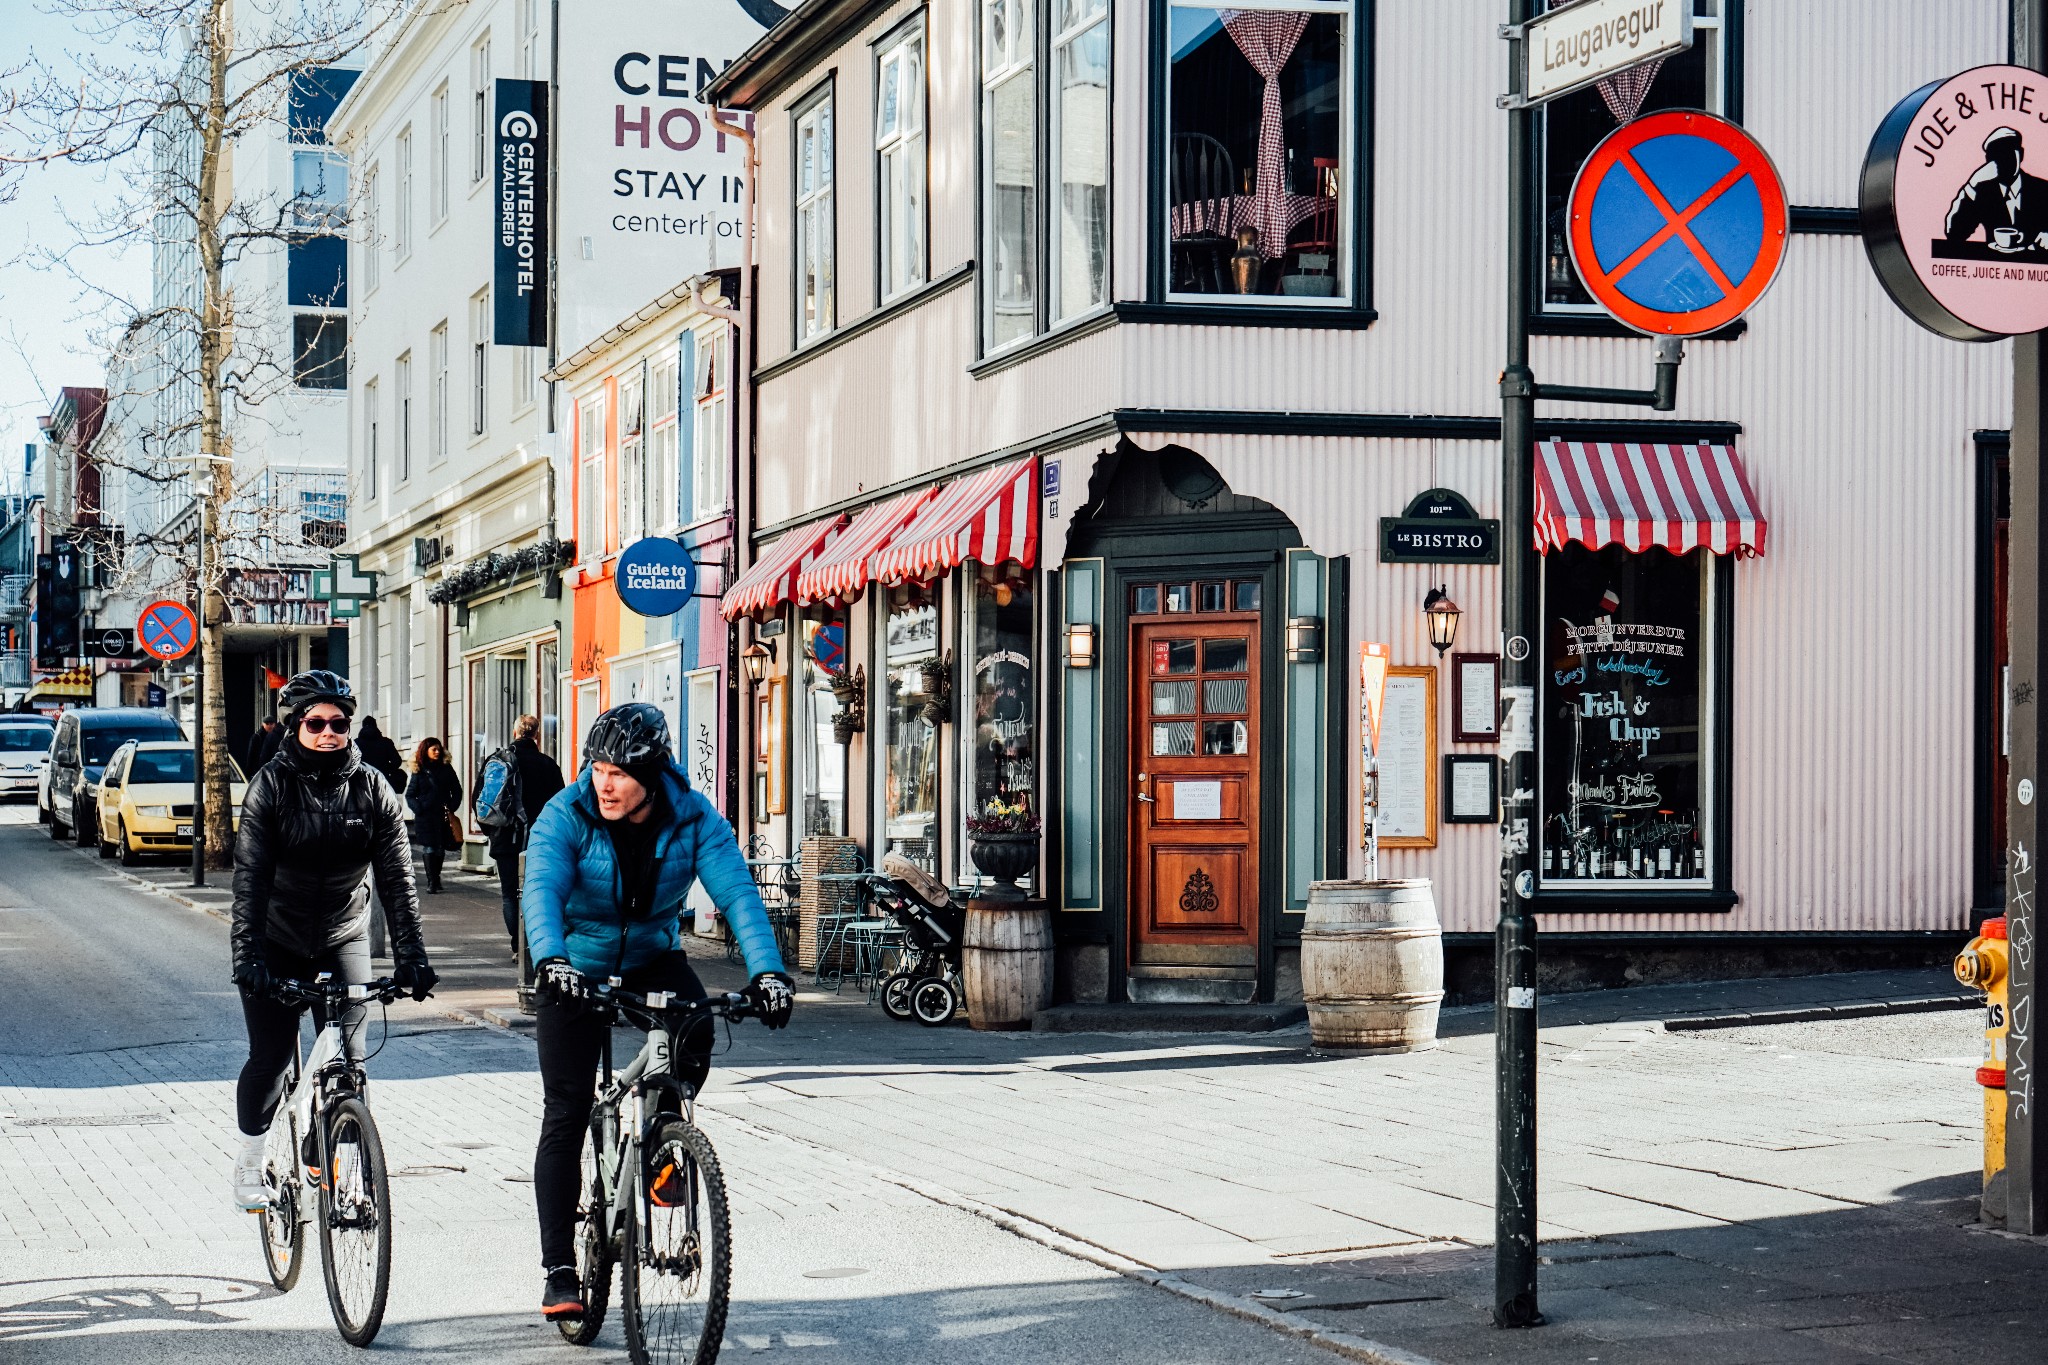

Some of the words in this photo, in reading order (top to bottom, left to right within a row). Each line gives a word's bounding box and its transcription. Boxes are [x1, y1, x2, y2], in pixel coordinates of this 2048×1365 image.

[1544, 0, 1663, 72] Laugavegur
[1914, 107, 1957, 168] JOE
[1954, 92, 1979, 120] &
[1981, 82, 2035, 115] THE
[613, 168, 707, 201] STAY
[517, 142, 535, 297] CENTERHOTEL
[1931, 264, 1971, 280] COFFEE,
[1972, 265, 2001, 280] JUICE
[2003, 268, 2025, 281] AND
[1397, 533, 1410, 542] LE
[1411, 534, 1483, 548] BISTRO
[626, 562, 670, 576] Guide
[671, 565, 687, 577] to
[626, 575, 687, 590] Iceland
[1566, 641, 1609, 656] PETIT
[1611, 638, 1685, 657] DÉJEUNER
[1554, 665, 1587, 686] Every
[1597, 653, 1671, 686] Wednesday
[1578, 690, 1627, 718] Fish
[1632, 694, 1651, 716] &
[1609, 717, 1661, 762] Chips
[1985, 1003, 2004, 1030] KS
